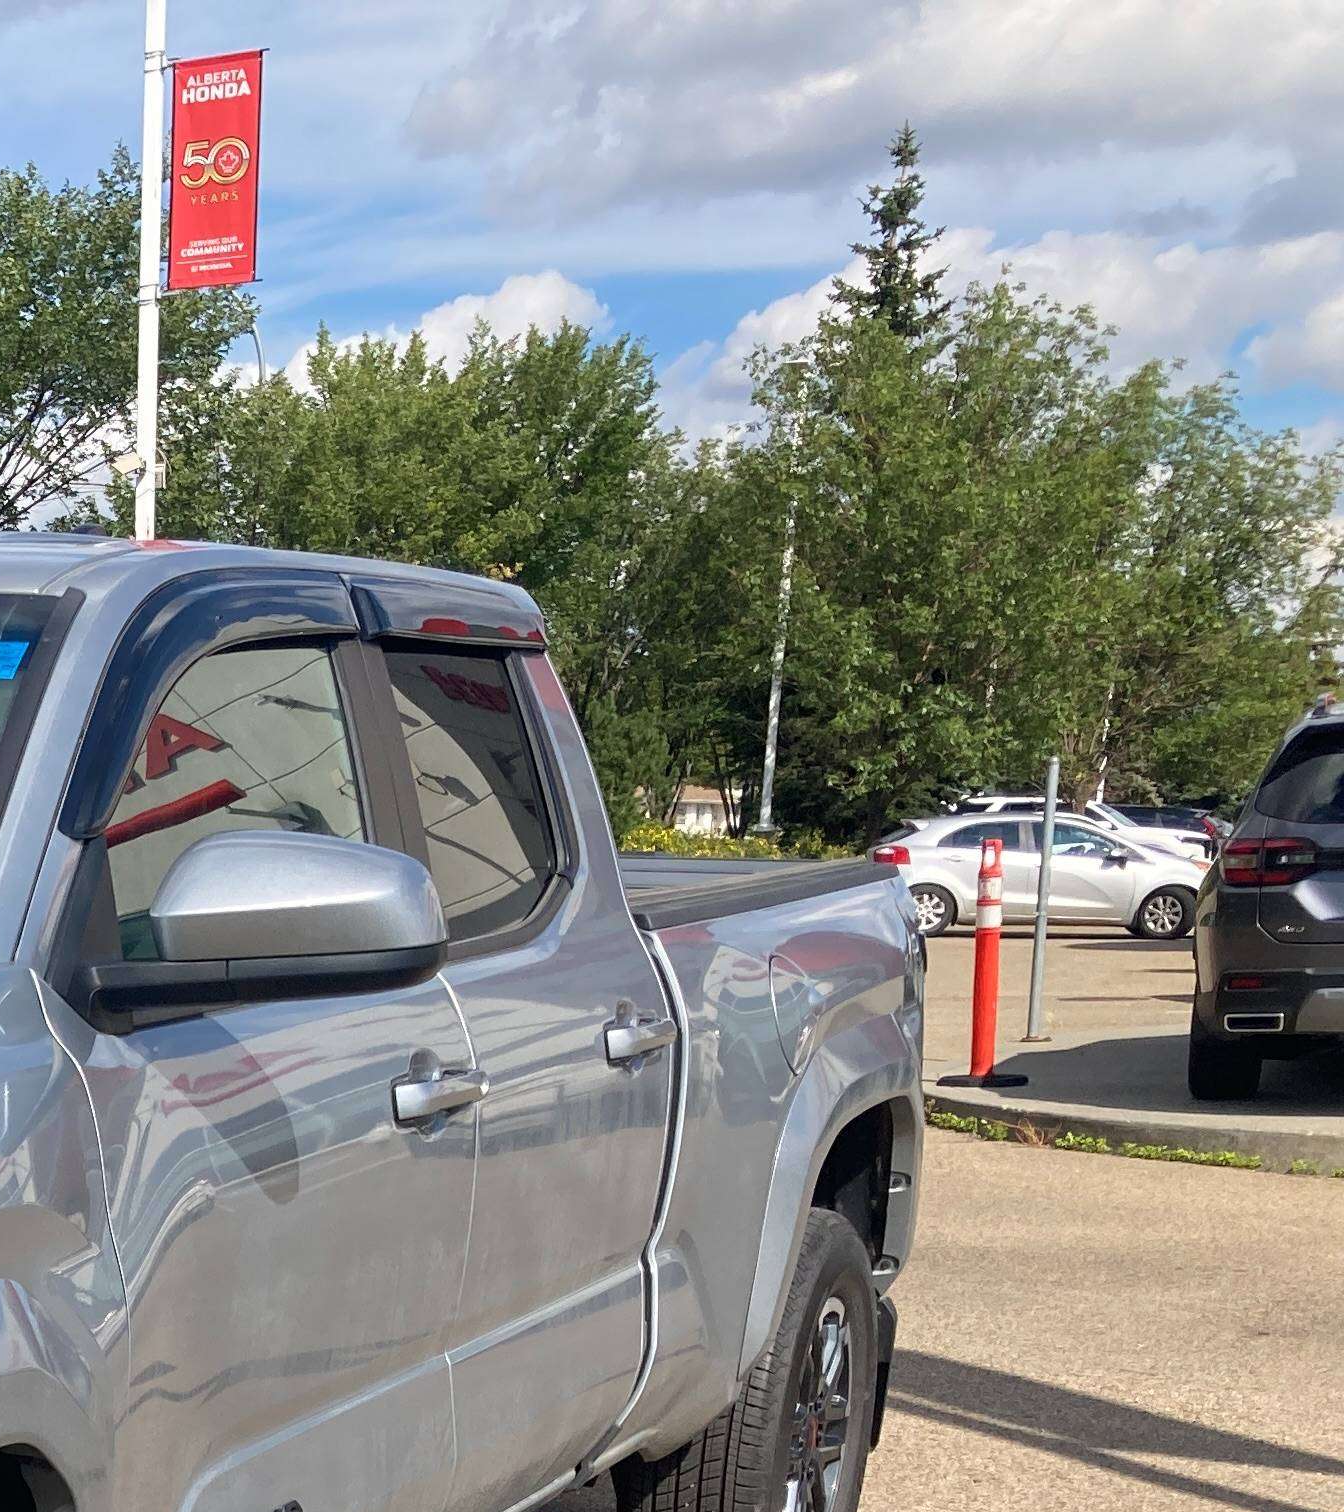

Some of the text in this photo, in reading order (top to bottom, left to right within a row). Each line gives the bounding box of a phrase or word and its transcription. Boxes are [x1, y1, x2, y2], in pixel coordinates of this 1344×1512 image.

[186, 68, 247, 88] ALBERTA
[182, 80, 251, 105] HONDA
[180, 136, 250, 189] 50
[191, 191, 239, 206] YEARS
[180, 242, 244, 257] COMMUNITY
